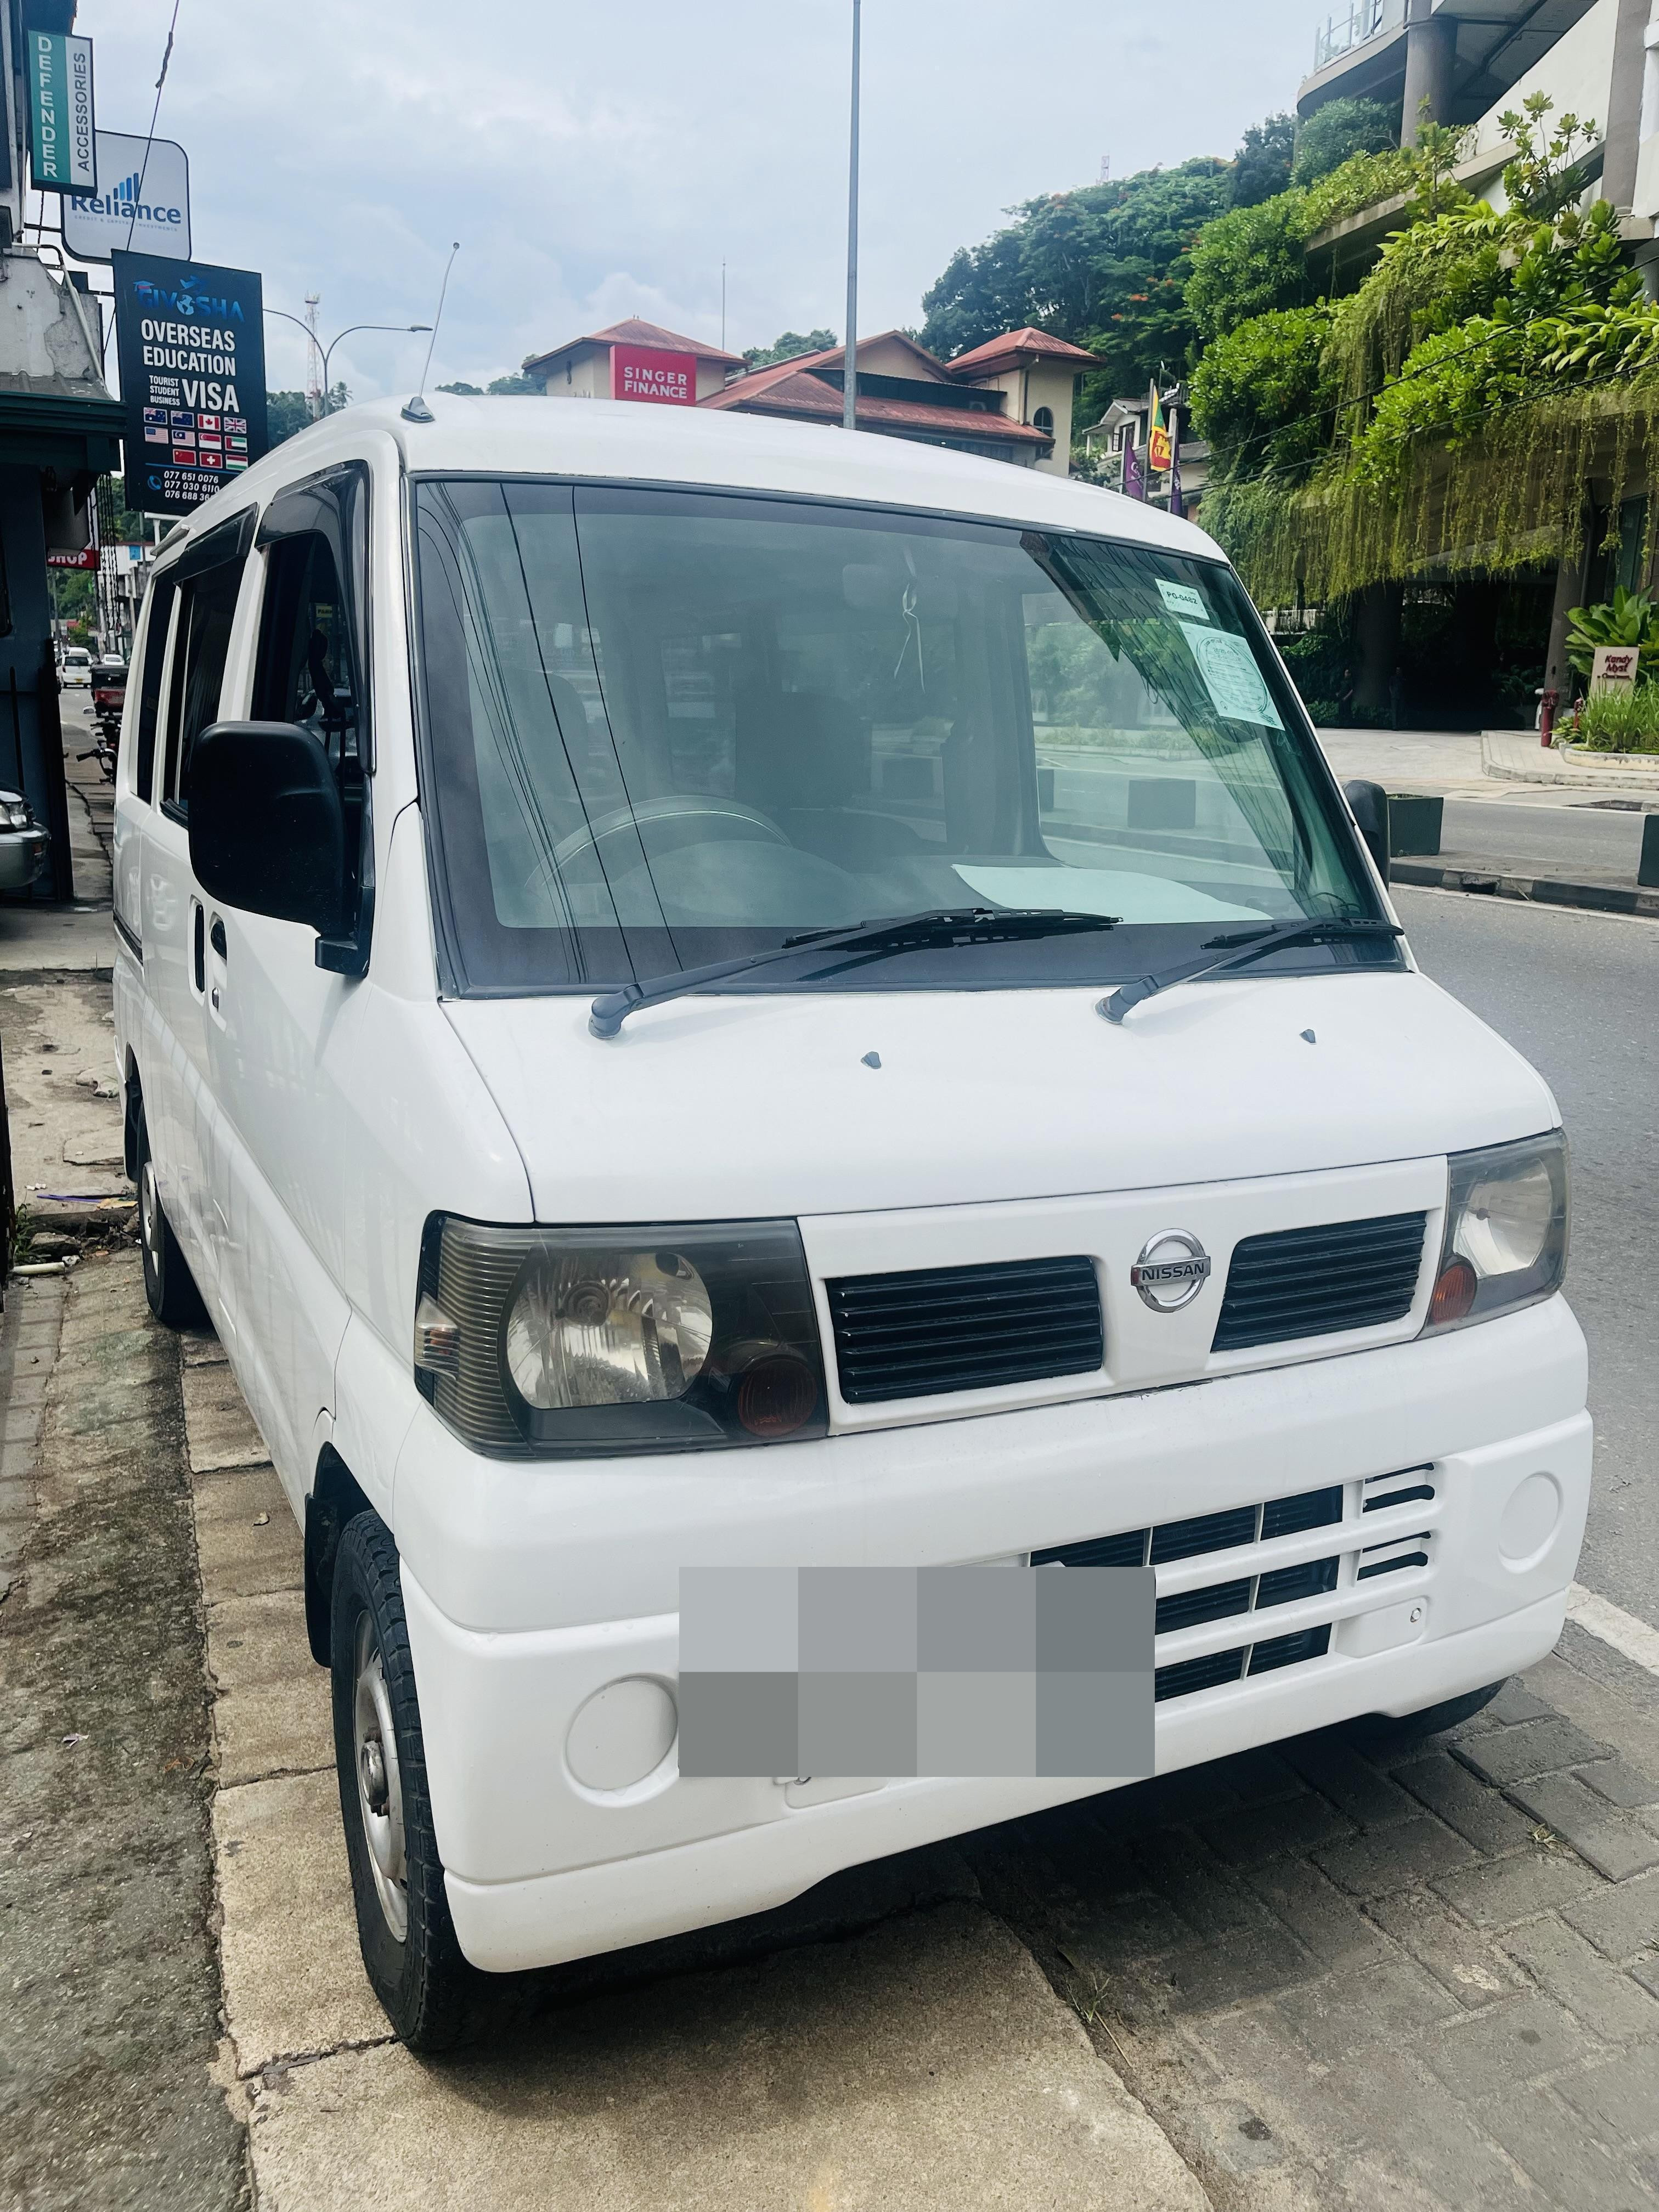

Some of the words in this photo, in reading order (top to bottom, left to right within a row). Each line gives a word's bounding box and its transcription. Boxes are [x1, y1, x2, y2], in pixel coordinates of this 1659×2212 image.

[38, 36, 58, 178] DEFENDER
[74, 53, 89, 172] ACCESSORIES
[71, 195, 182, 224] Reliance
[141, 319, 236, 352] OVERSEAS
[143, 345, 236, 376] EDUCATION
[149, 375, 179, 387] TOURIST
[624, 366, 687, 386] SINGER
[149, 386, 180, 397] STUDENT
[182, 379, 240, 413] VISA
[624, 380, 687, 399] FINANCE
[150, 395, 180, 406] BUSINESS
[164, 470, 180, 480] 077
[182, 472, 196, 481] 651
[198, 474, 219, 484] 0076
[165, 480, 181, 489] 077
[183, 482, 200, 492] 030
[202, 484, 220, 493] 6110
[165, 489, 180, 499] 076
[1142, 1262, 1204, 1281] NISSAN
